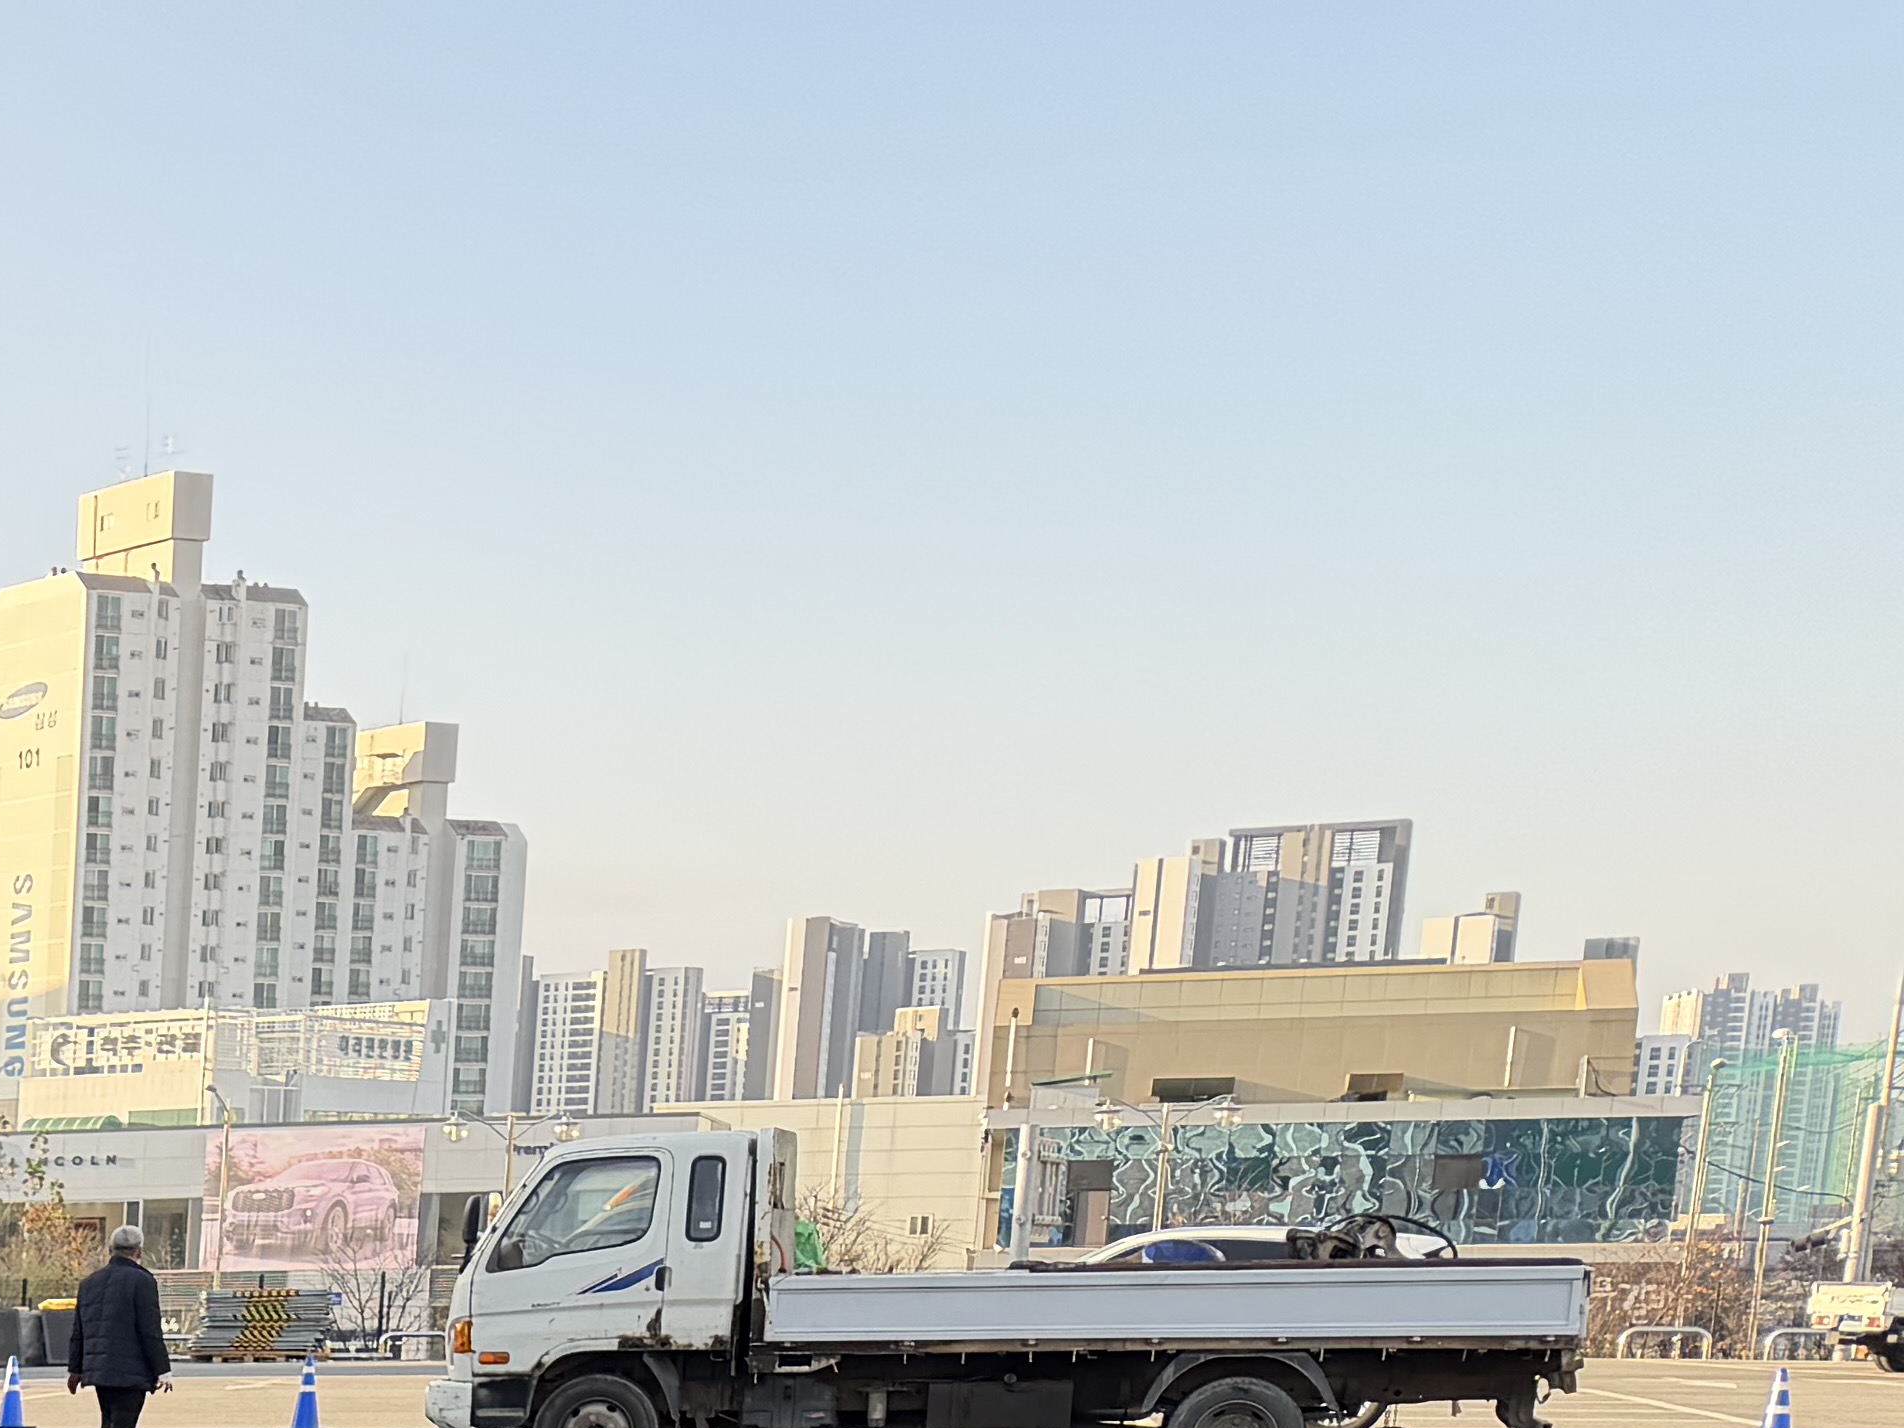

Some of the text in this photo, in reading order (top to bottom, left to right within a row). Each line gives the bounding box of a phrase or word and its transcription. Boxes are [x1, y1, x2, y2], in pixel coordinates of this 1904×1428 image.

[18, 748, 40, 770] 101
[4, 873, 34, 1078] SAMSUNG
[8, 1155, 118, 1168] LNCOLN
